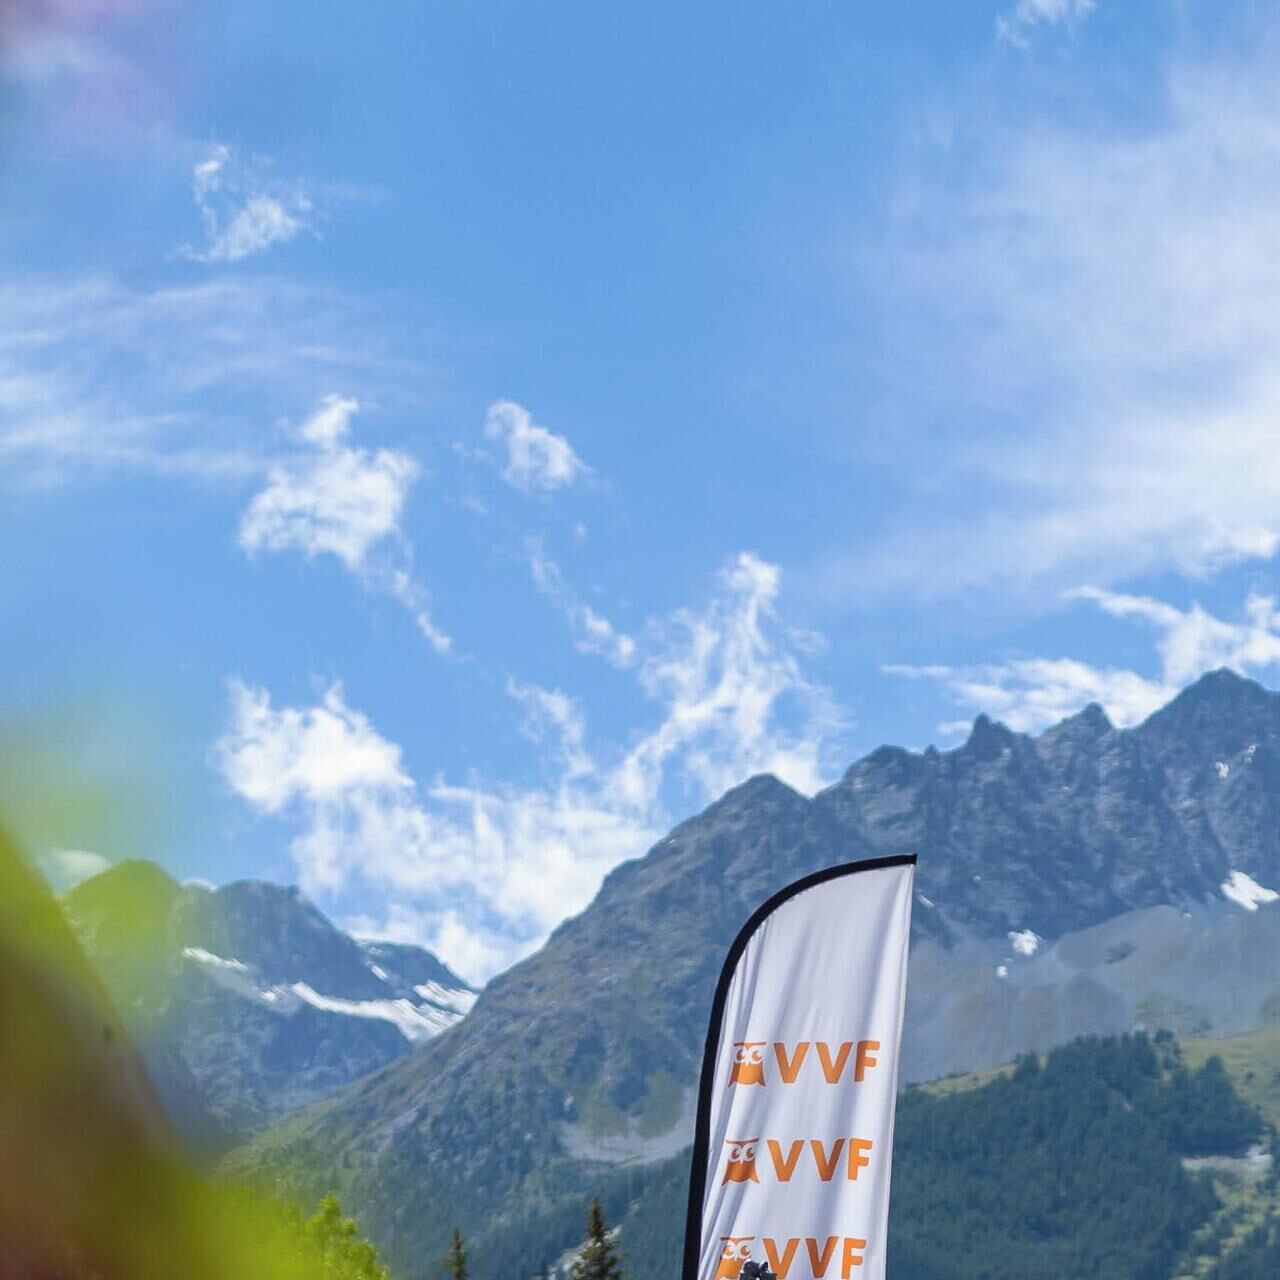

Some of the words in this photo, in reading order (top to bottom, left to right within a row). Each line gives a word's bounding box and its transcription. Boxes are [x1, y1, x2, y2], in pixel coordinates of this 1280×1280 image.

[773, 1040, 880, 1084] VVF
[767, 1138, 873, 1182] VVF
[762, 1236, 867, 1280] VVF
